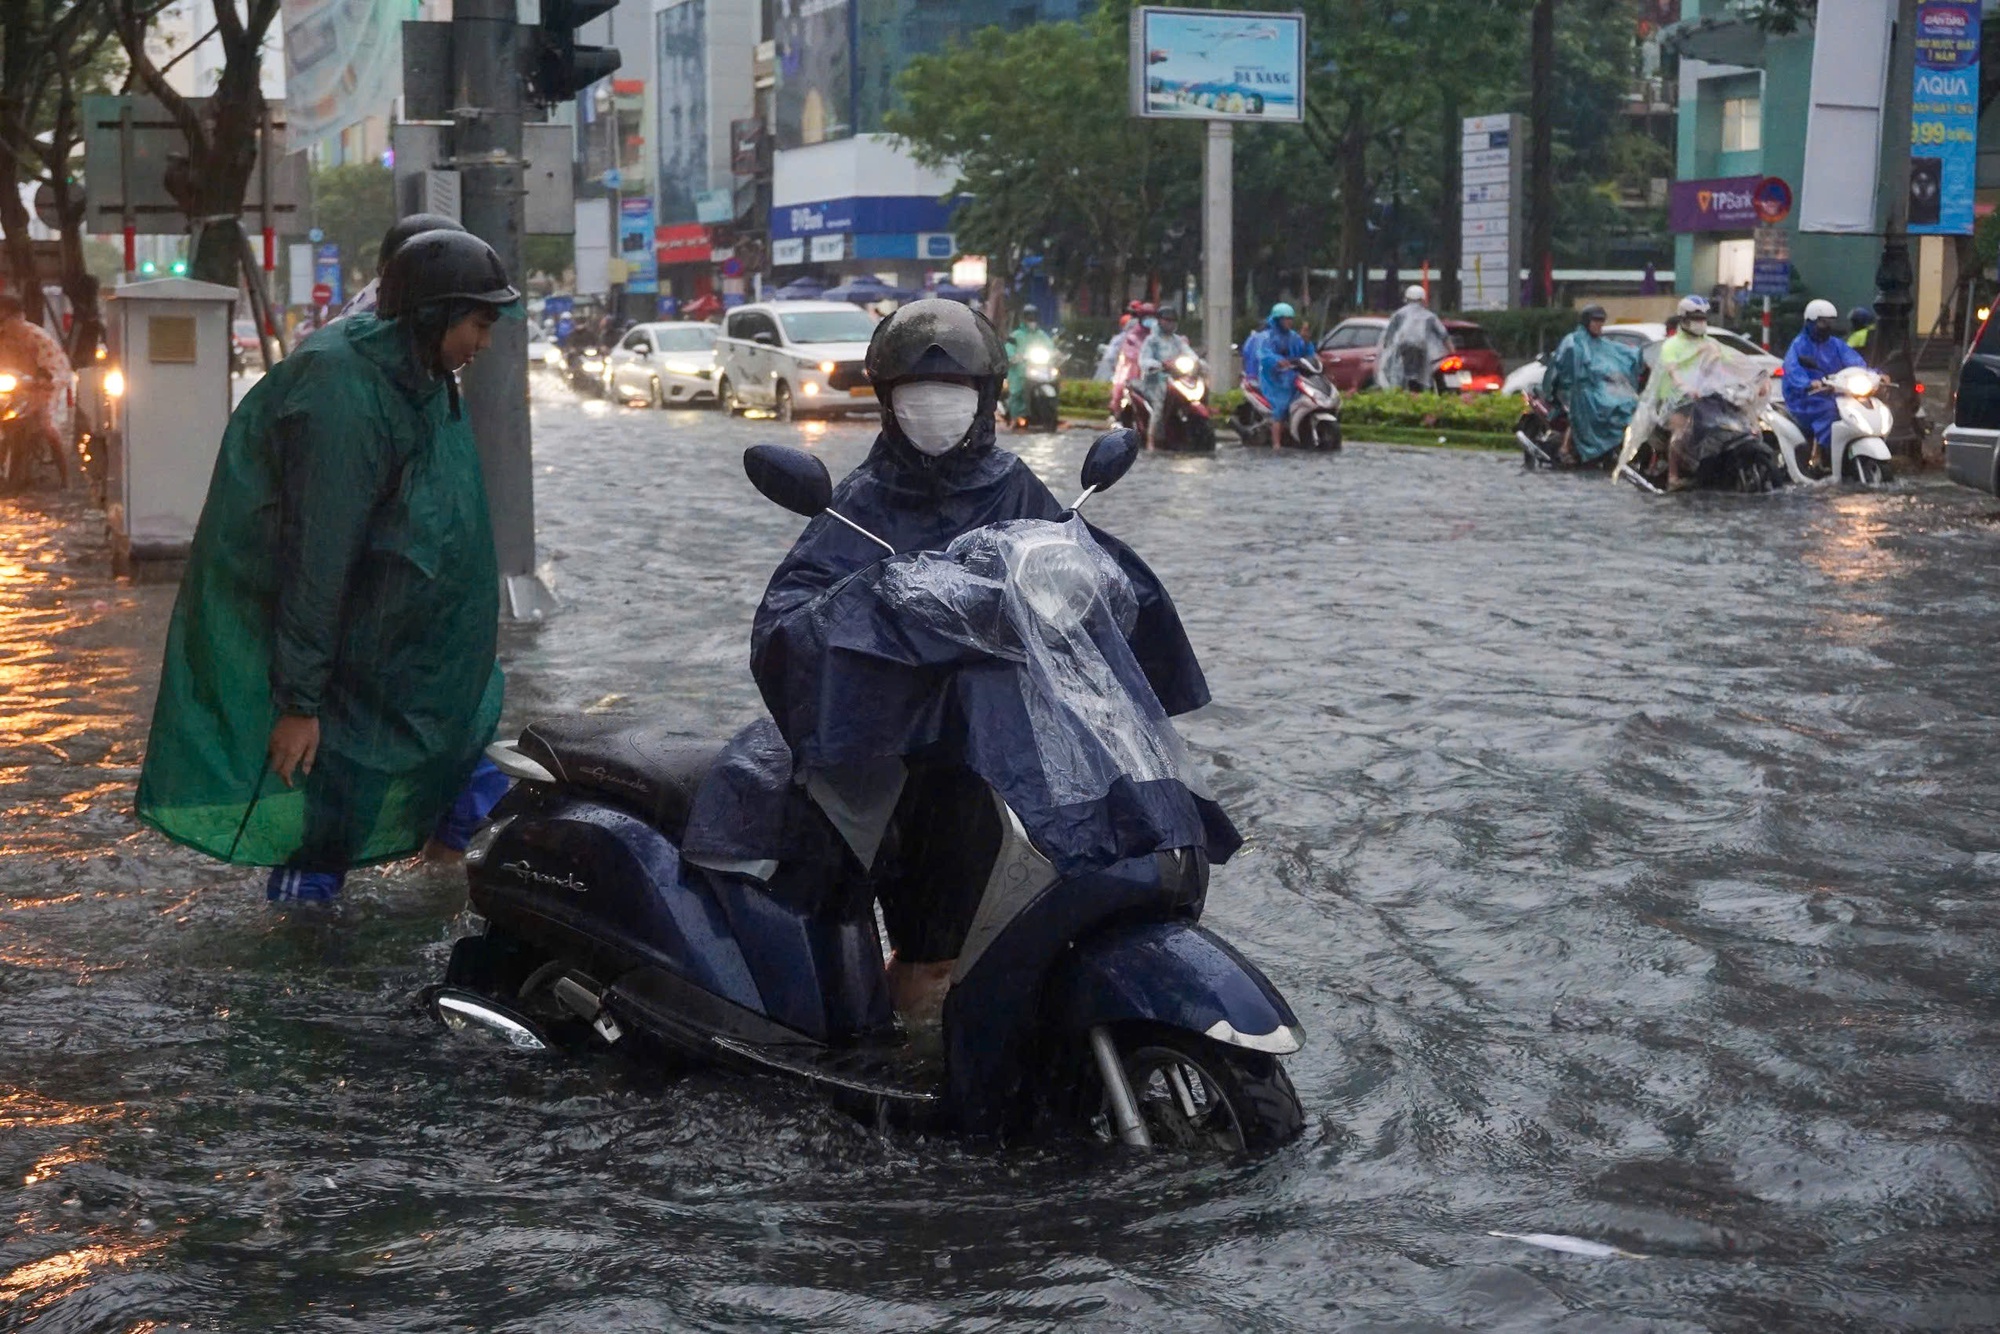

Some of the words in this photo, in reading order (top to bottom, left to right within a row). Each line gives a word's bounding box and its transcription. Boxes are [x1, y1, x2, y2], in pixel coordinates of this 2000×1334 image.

[1916, 76, 1969, 95] AQUA
[1712, 190, 1754, 210] TPBank
[500, 860, 588, 892] Grande
